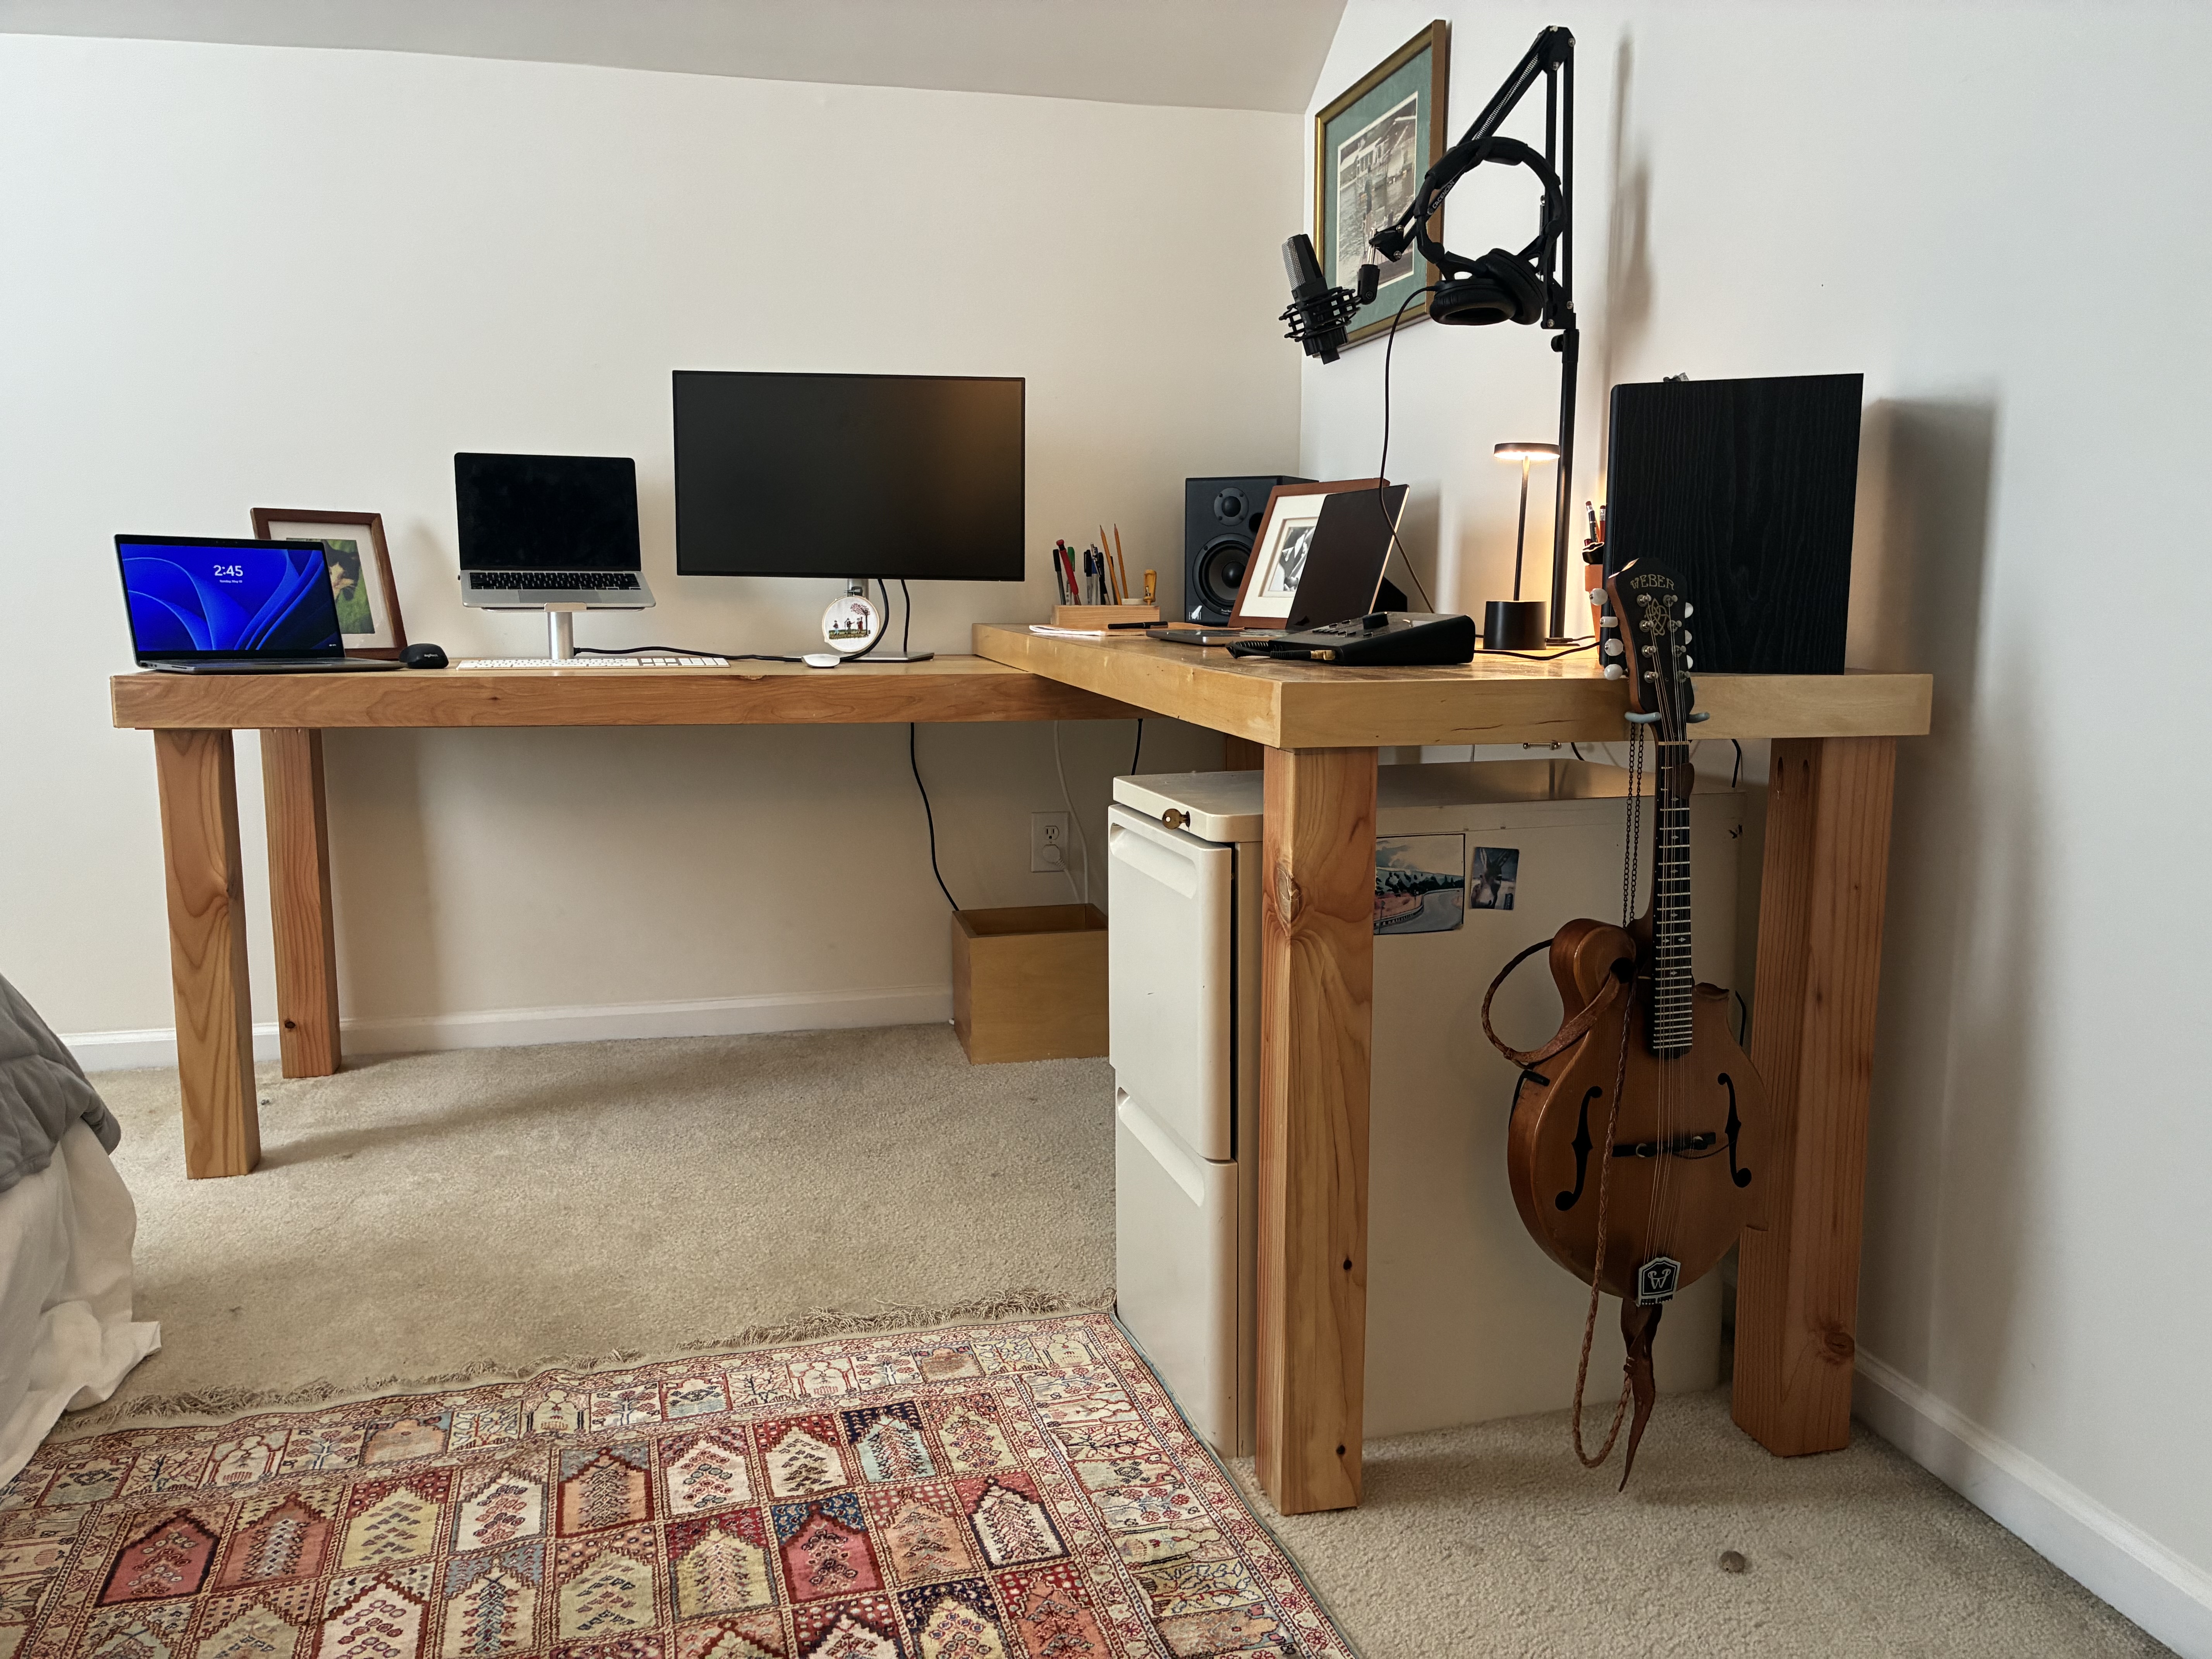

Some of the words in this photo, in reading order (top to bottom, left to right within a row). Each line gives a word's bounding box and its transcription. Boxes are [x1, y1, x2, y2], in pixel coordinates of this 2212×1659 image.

[1432, 180, 1455, 209] CACENCAN
[213, 565, 243, 577] 2:45
[1630, 574, 1674, 591] WEBER
